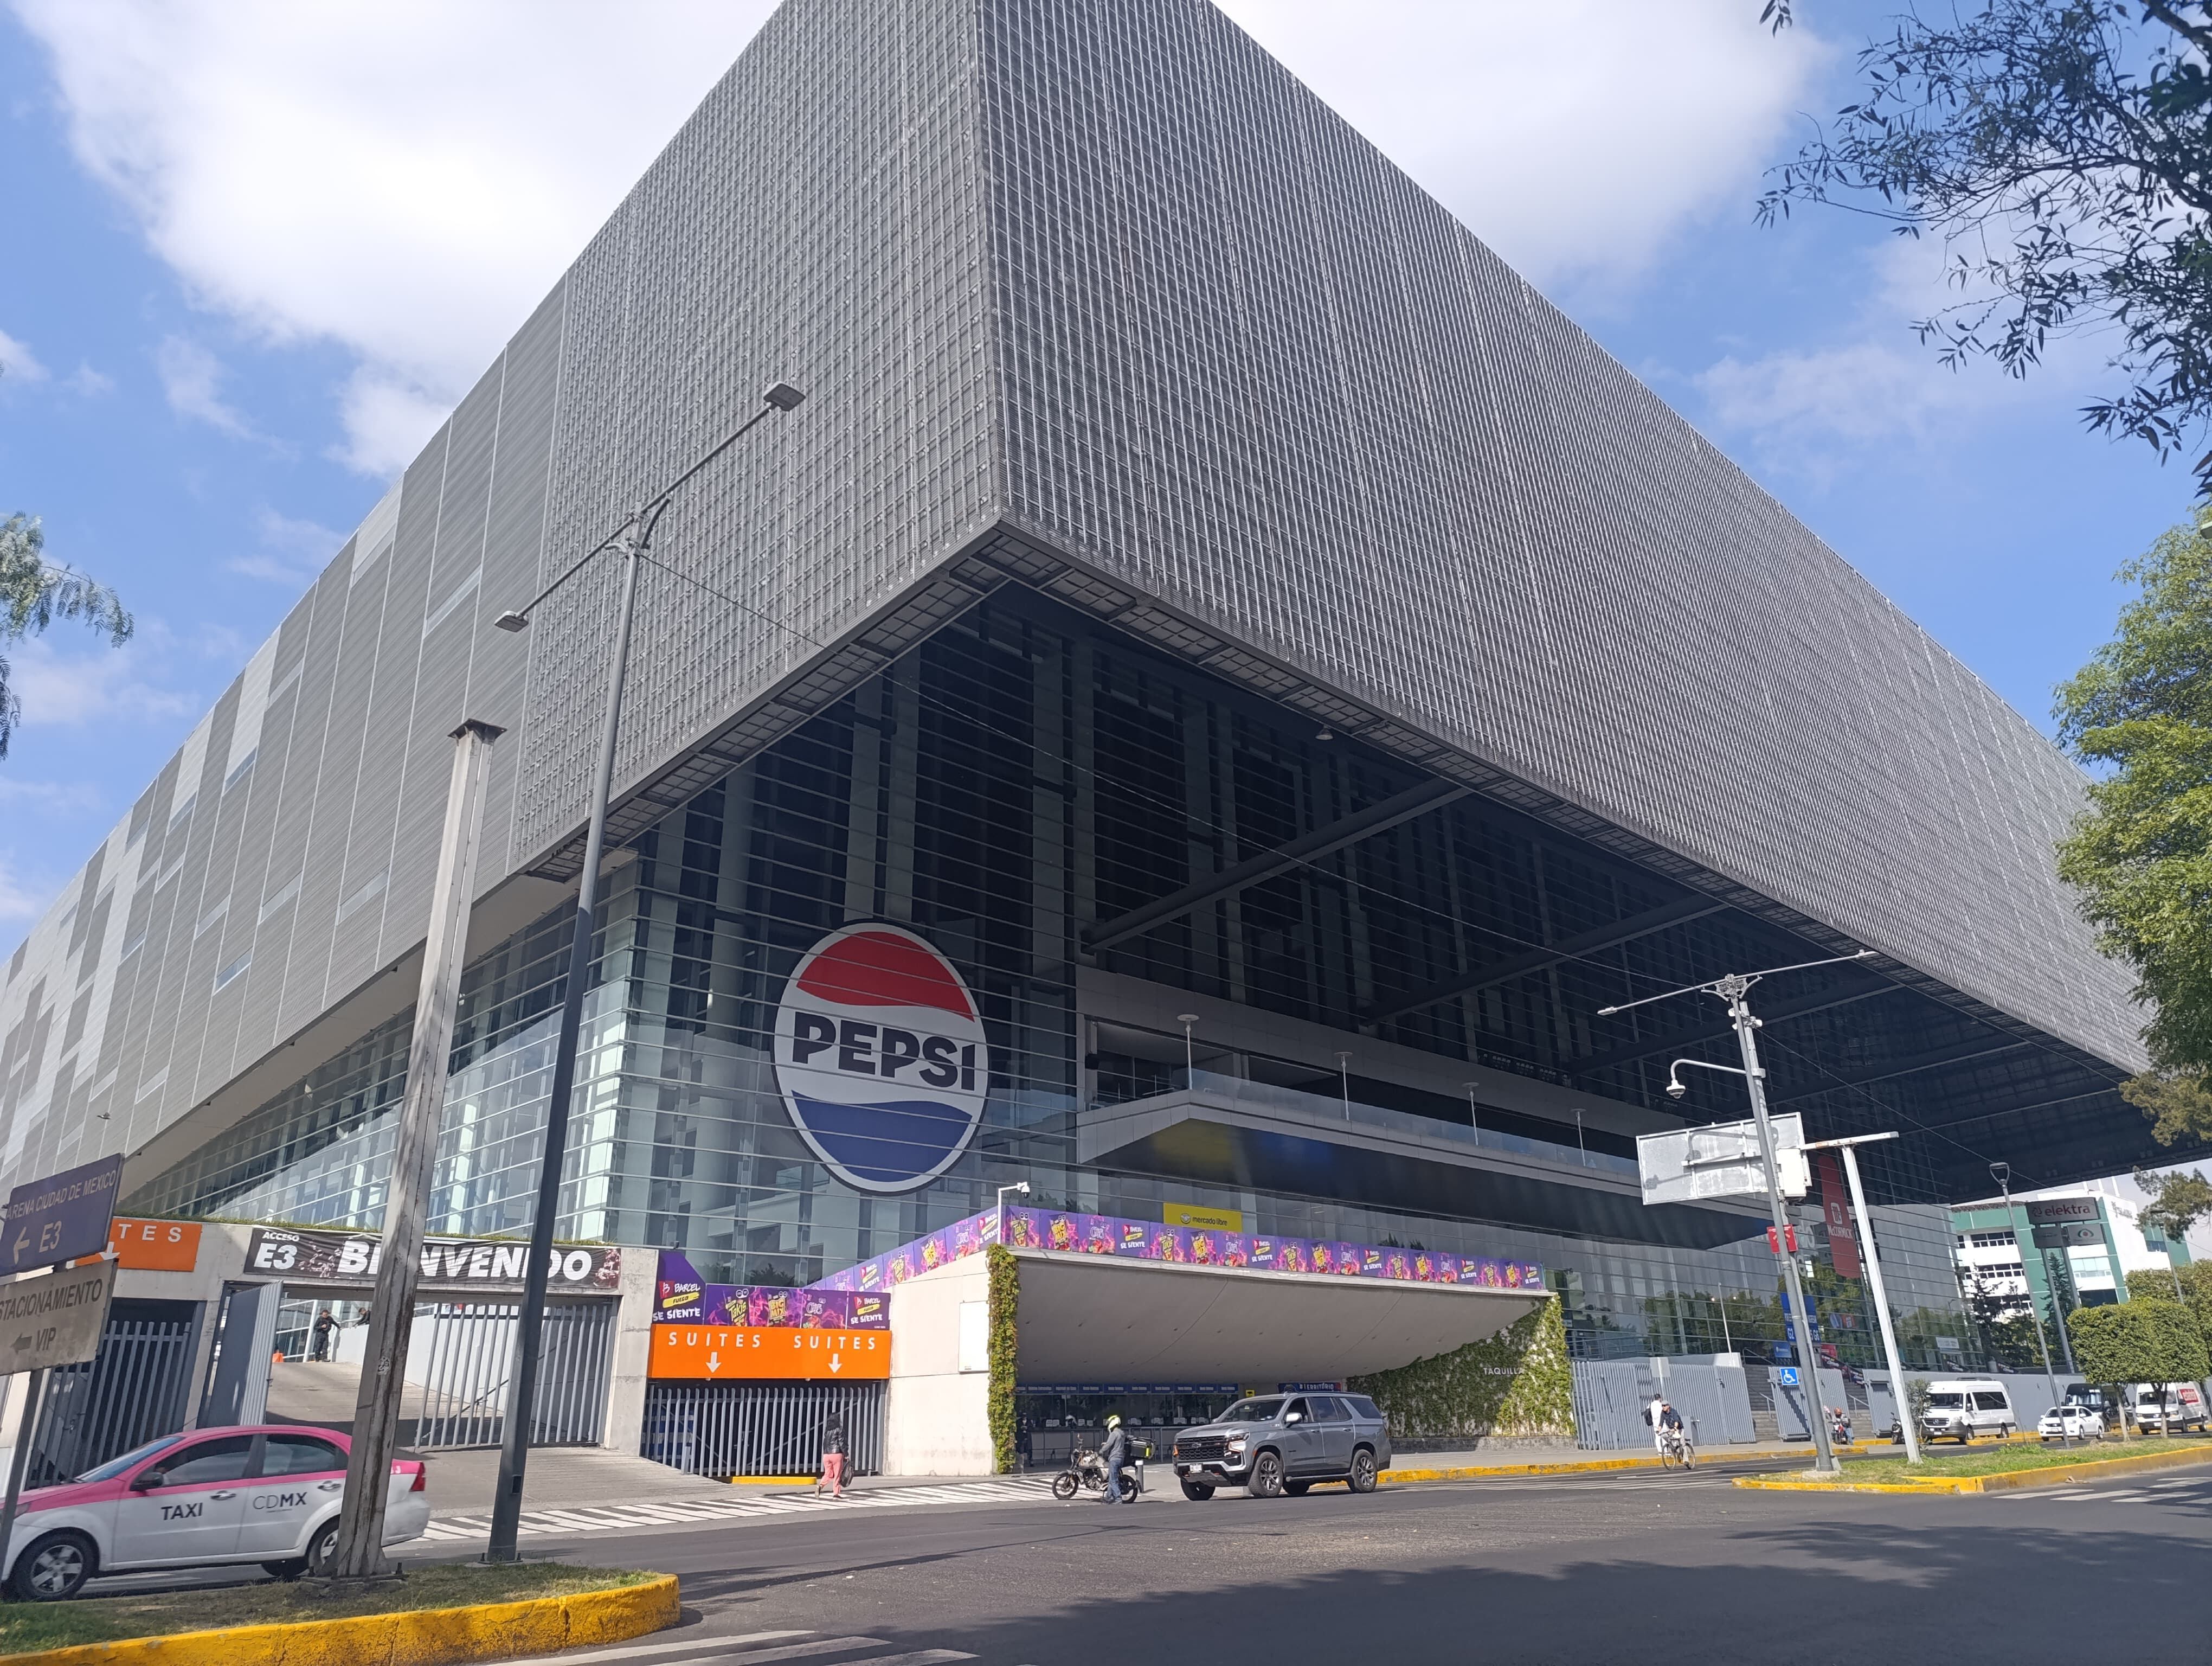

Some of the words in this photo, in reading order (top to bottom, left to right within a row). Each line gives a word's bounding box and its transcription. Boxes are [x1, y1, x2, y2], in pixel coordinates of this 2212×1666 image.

[792, 1011, 975, 1091] PEPSI
[7, 1200, 34, 1220] ARENA
[36, 1187, 67, 1211] CIUDAD
[68, 1182, 82, 1200] DE
[82, 1170, 117, 1196] MEXICO
[2044, 1204, 2091, 1216] elektra
[1193, 1216, 1216, 1225] mercado
[1216, 1218, 1228, 1226] libre
[39, 1220, 62, 1253] E3
[119, 1223, 182, 1242] TES
[262, 1232, 300, 1242] ACCESO
[254, 1242, 298, 1270] E3
[674, 1283, 701, 1293] BARCEL
[0, 1279, 102, 1321] STACIONAMIENTO
[673, 1296, 689, 1304] FUEGO
[770, 1299, 785, 1310] BIG
[653, 1311, 664, 1321] SE
[667, 1307, 700, 1319] SIENTE
[729, 1302, 747, 1322] Takis
[771, 1307, 785, 1318] MIX
[851, 1316, 859, 1324] SE
[860, 1313, 883, 1323] SIENTE
[36, 1327, 56, 1351] VIP
[668, 1332, 761, 1348] SUITES
[794, 1335, 876, 1350] SUITES
[253, 1491, 308, 1511] CDMX
[161, 1503, 203, 1520] TAXI
